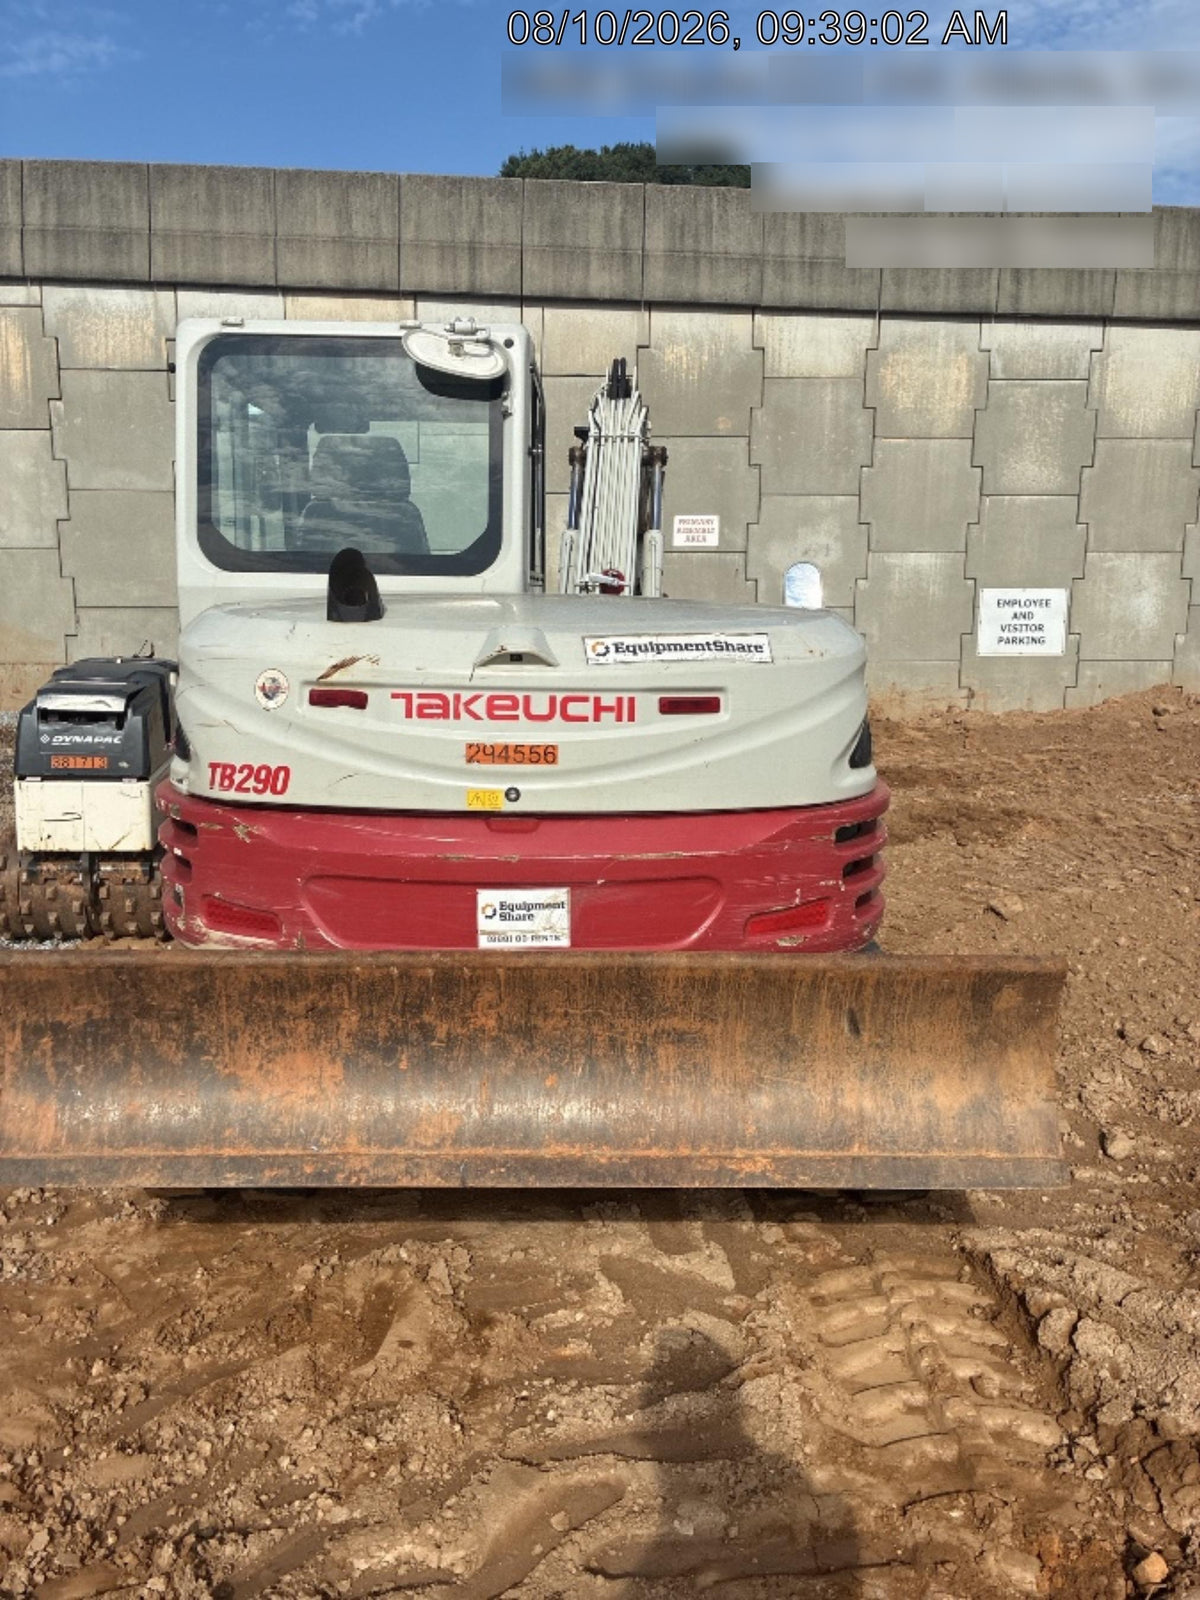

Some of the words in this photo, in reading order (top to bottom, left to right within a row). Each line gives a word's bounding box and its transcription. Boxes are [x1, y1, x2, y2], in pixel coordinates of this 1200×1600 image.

[997, 598, 1052, 609] EMPLOYEE
[1011, 611, 1034, 621] AND
[1000, 623, 1045, 633] VISITOR
[997, 635, 1046, 646] PARKING
[613, 640, 765, 655] EquipmentShare
[51, 735, 123, 745] DYNAPAC
[467, 743, 557, 764] 294556
[208, 762, 291, 795] TB290
[499, 901, 565, 912] Equipment
[499, 912, 535, 921] Share
